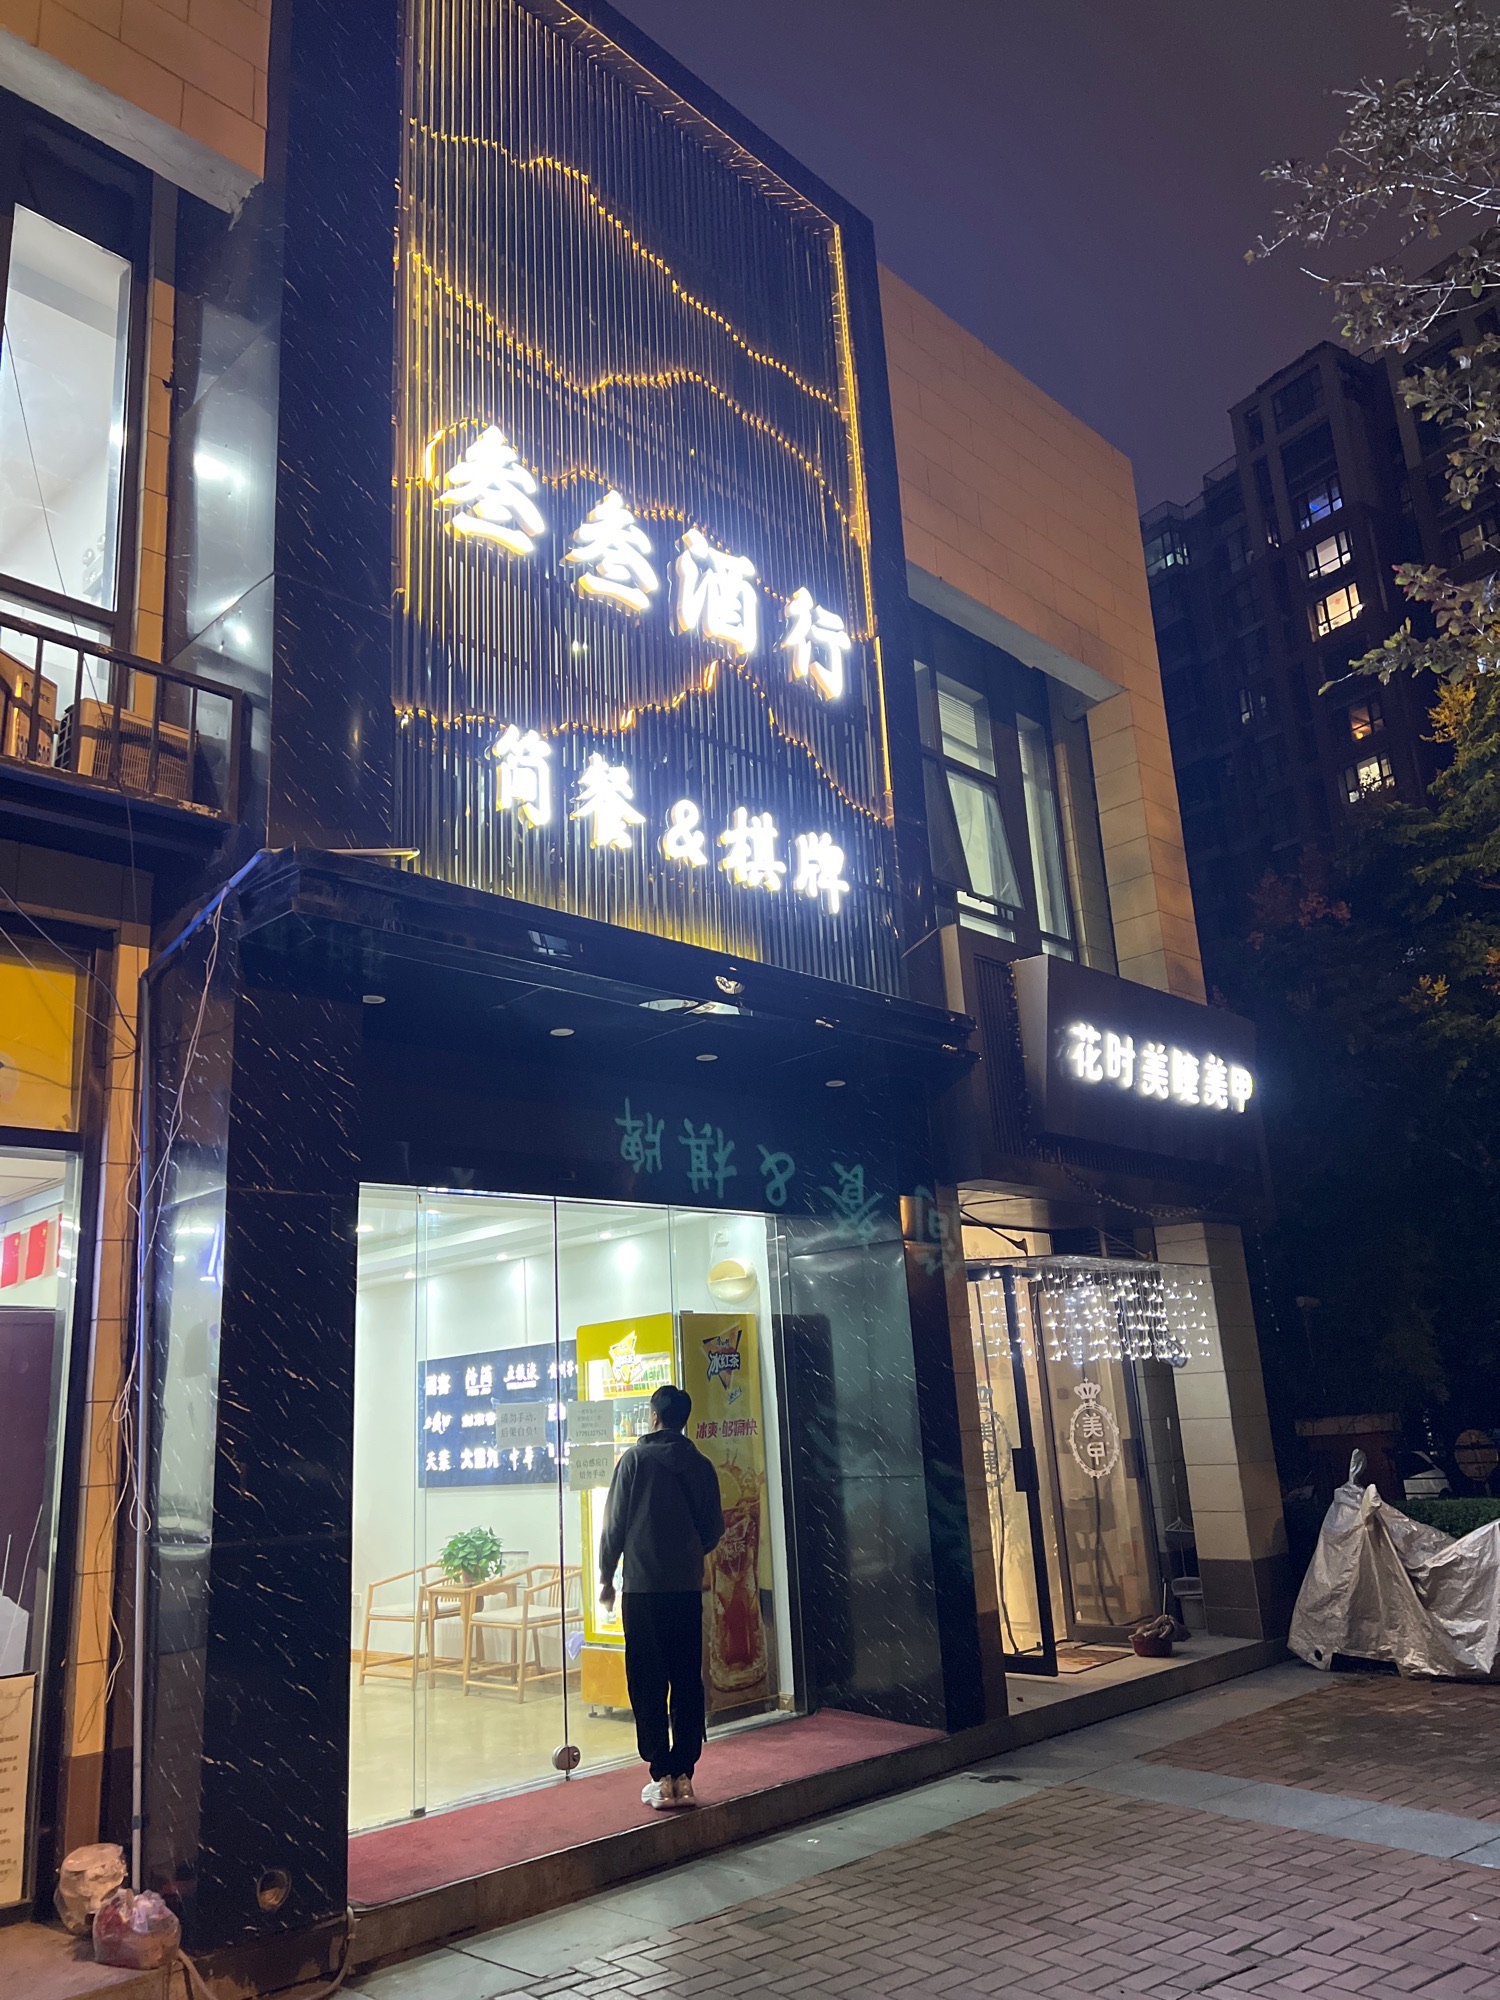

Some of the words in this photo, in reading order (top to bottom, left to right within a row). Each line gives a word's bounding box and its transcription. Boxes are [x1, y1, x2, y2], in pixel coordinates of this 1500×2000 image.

[488, 724, 850, 914] 简餐&棋牌
[1068, 1022, 1254, 1114] 花时美睫美甲
[708, 1352, 740, 1377] 冰红茶
[1081, 1413, 1106, 1466] 美甲
